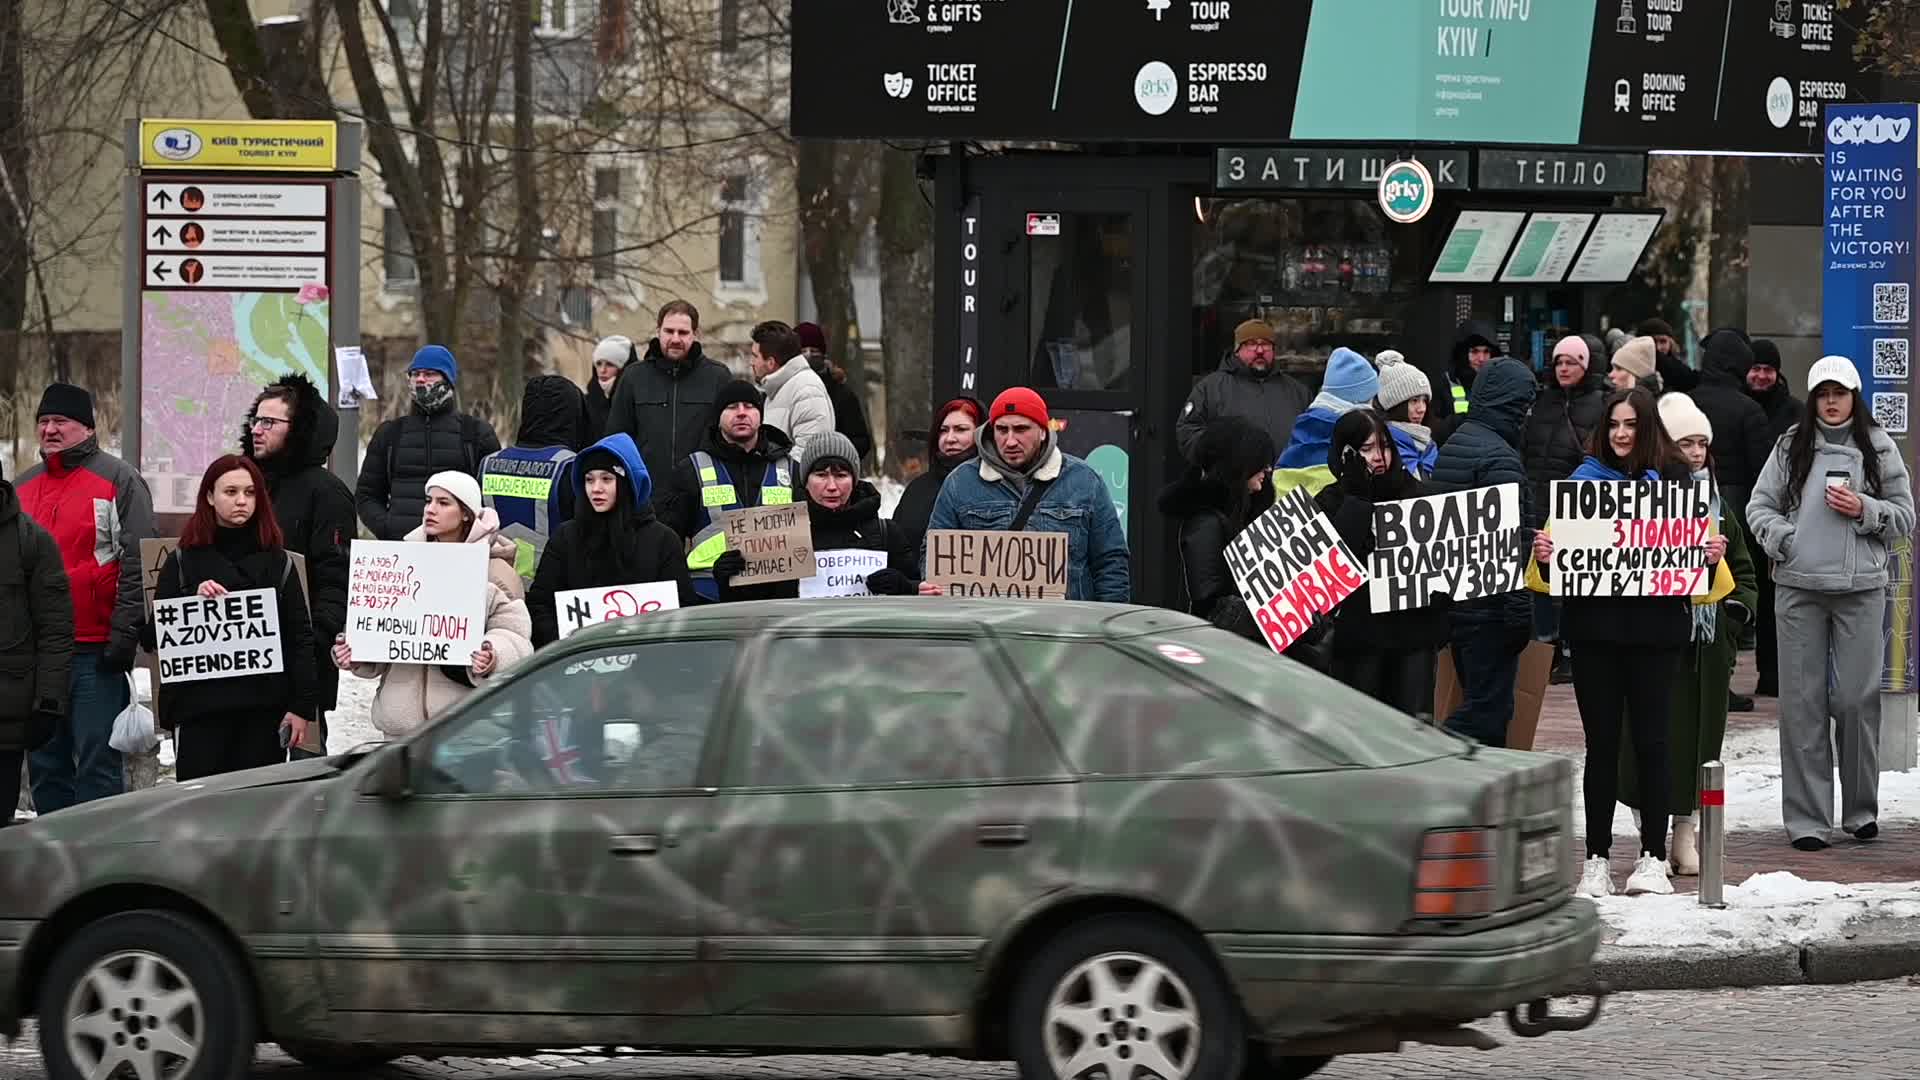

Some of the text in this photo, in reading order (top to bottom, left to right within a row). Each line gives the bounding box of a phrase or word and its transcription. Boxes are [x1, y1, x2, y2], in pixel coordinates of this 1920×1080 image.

[927, 4, 982, 22] & GIFTS
[1190, 1, 1230, 20] TOUR
[1802, 3, 1833, 21] TICKET
[1646, 13, 1672, 31] TOUR
[1801, 23, 1833, 41] OFFICE
[1438, 26, 1478, 57] KYIV
[927, 63, 977, 82] TICKET
[1188, 63, 1267, 82] ESPRESSO
[1642, 73, 1686, 92] BOOKING
[1799, 80, 1847, 99] ESPRESSO
[927, 84, 978, 102] OFFICE
[1188, 84, 1220, 102] BAR
[1641, 92, 1677, 112] OFFICE
[1799, 100, 1818, 117] BAR
[1833, 124, 1902, 138] KYIV
[211, 136, 325, 148] КИЇВ ТУРИСТИЧНИЙ
[239, 149, 298, 158] TOURIST KYIV
[1831, 150, 1847, 165] IS
[1229, 156, 1455, 183] ЗАТИШК
[1516, 159, 1606, 185] ТЕПЛО
[1830, 168, 1904, 183] WAITING
[1386, 179, 1422, 202] grky
[1831, 185, 1907, 201] FOR YOU
[1830, 204, 1886, 219] AFTER
[1830, 223, 1864, 237] THE
[1830, 240, 1910, 255] VICTORY!
[962, 217, 977, 390] TOUR IN
[730, 518, 747, 534] НЕ
[1375, 487, 1501, 549] ВОЛЮ
[1612, 518, 1710, 549] З ПОЛОНУ
[817, 556, 884, 569] ОВЕРНІТЬ
[827, 573, 865, 588] СИНА
[1562, 572, 1603, 596] НГУ
[1648, 566, 1705, 596] 3057
[157, 594, 265, 627] #FREE
[160, 619, 277, 650] AZOVSTAL
[356, 614, 469, 641] НЕ МОВЧИ ПОЛОН
[388, 639, 451, 662] ВБИВАЄ
[160, 648, 274, 679] DEFENDERS
